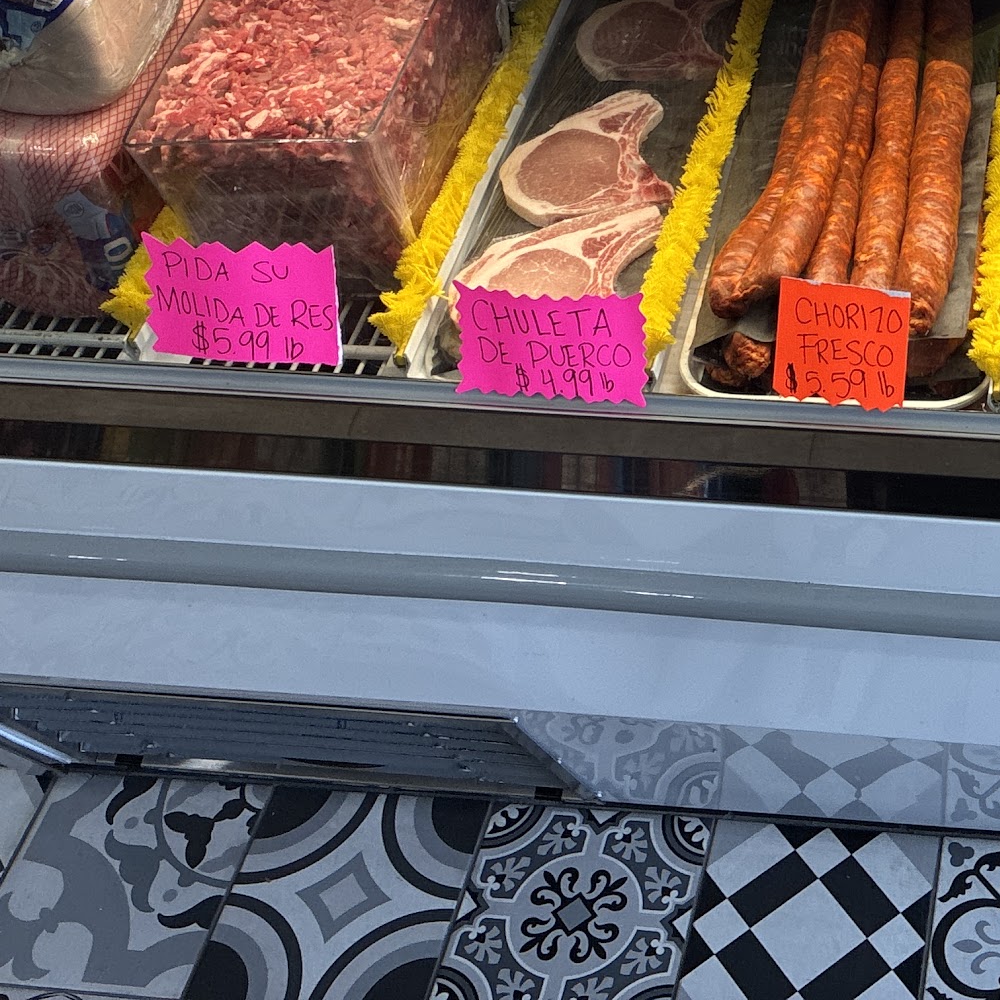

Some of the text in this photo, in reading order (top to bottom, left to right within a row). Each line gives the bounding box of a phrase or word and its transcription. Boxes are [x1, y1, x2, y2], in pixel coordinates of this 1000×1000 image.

[162, 251, 289, 283] PIDA SU
[156, 285, 334, 330] MOLIDA DE RES
[471, 299, 612, 337] CHULETA
[795, 297, 903, 334] CHORIZO
[192, 320, 304, 360] $5.99 lb
[477, 336, 632, 369] DE PUERCO
[796, 334, 894, 368] FRESCO
[599, 372, 615, 393] lb
[877, 371, 895, 397] lb
